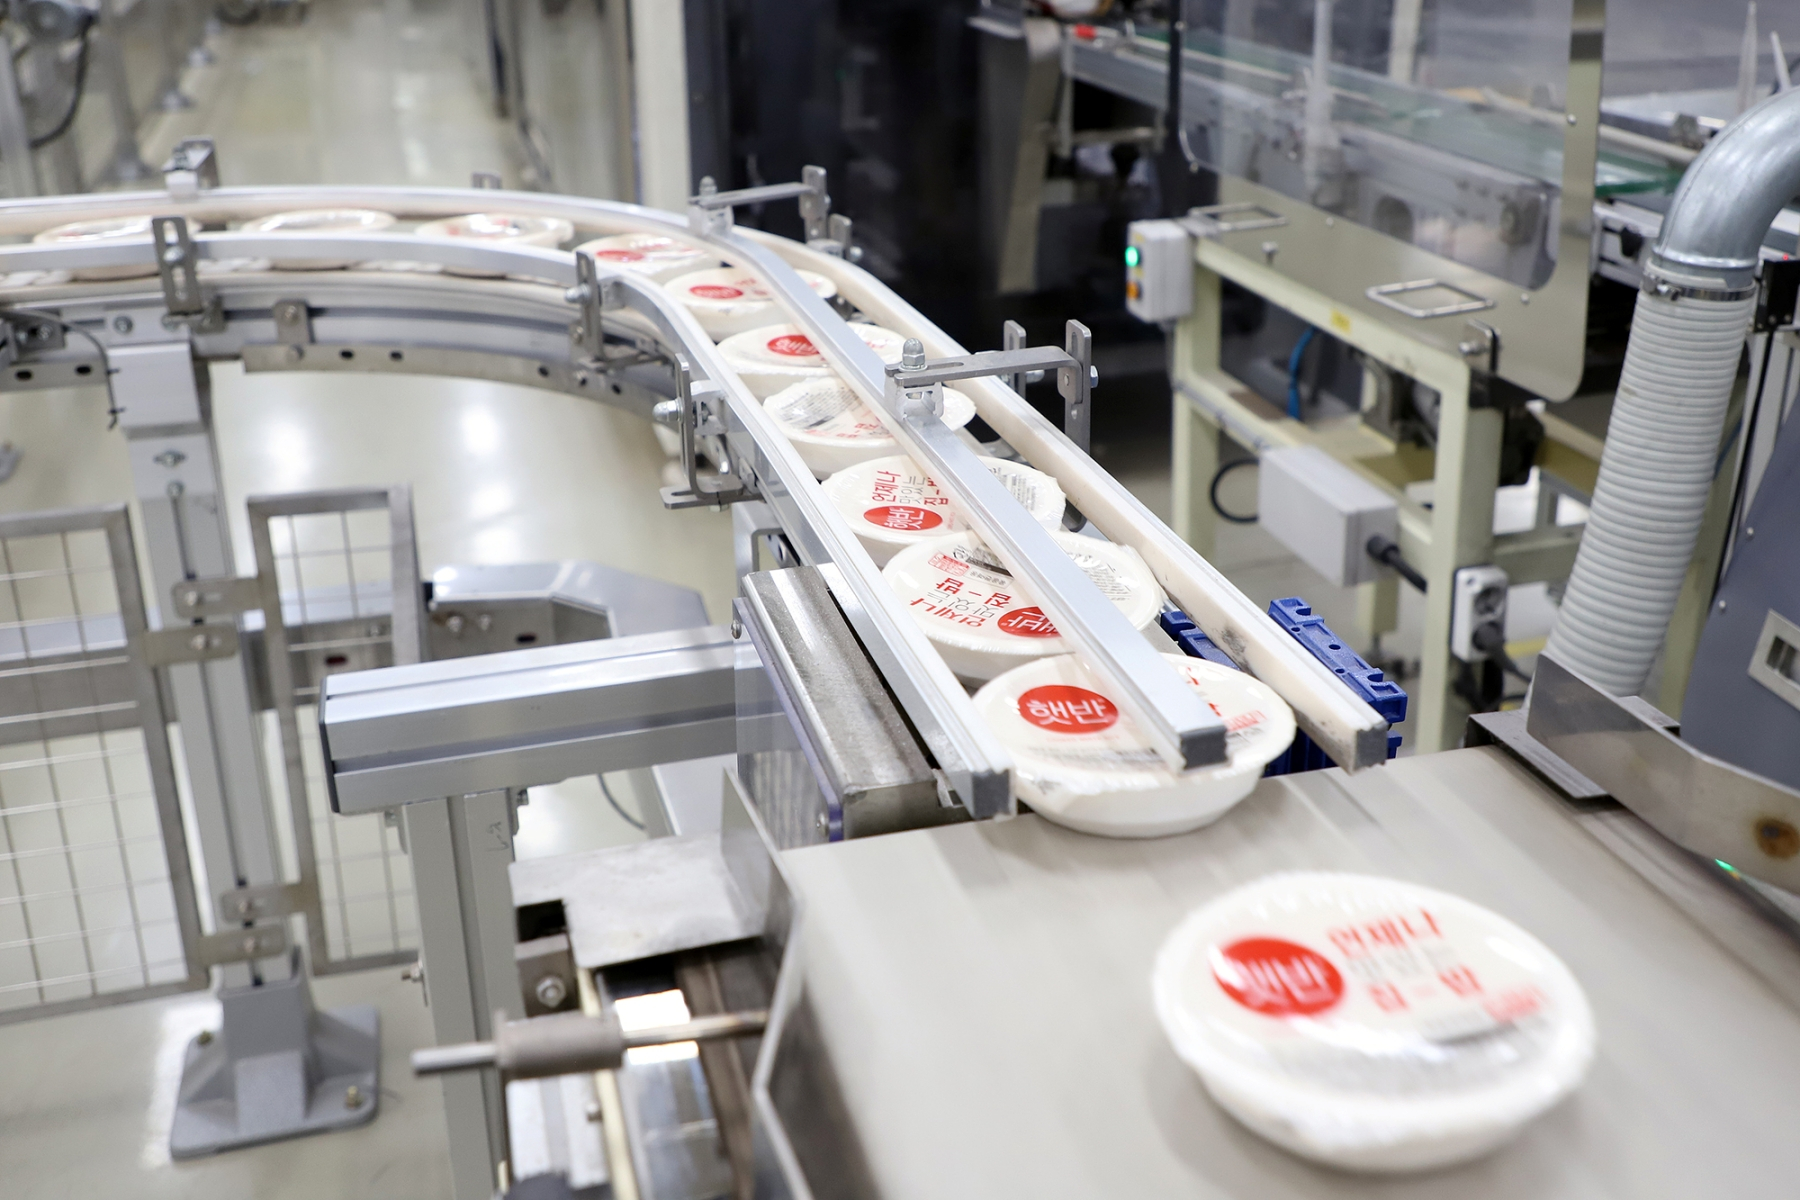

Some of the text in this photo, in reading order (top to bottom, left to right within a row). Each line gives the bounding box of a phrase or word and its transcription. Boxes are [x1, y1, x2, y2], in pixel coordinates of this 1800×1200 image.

[872, 470, 901, 502] 언제나
[899, 475, 926, 504] 맛있는
[884, 507, 925, 529] 햇반
[909, 597, 986, 627] 언제나
[927, 589, 998, 618] 맛있는
[1025, 699, 1108, 725] 햇반
